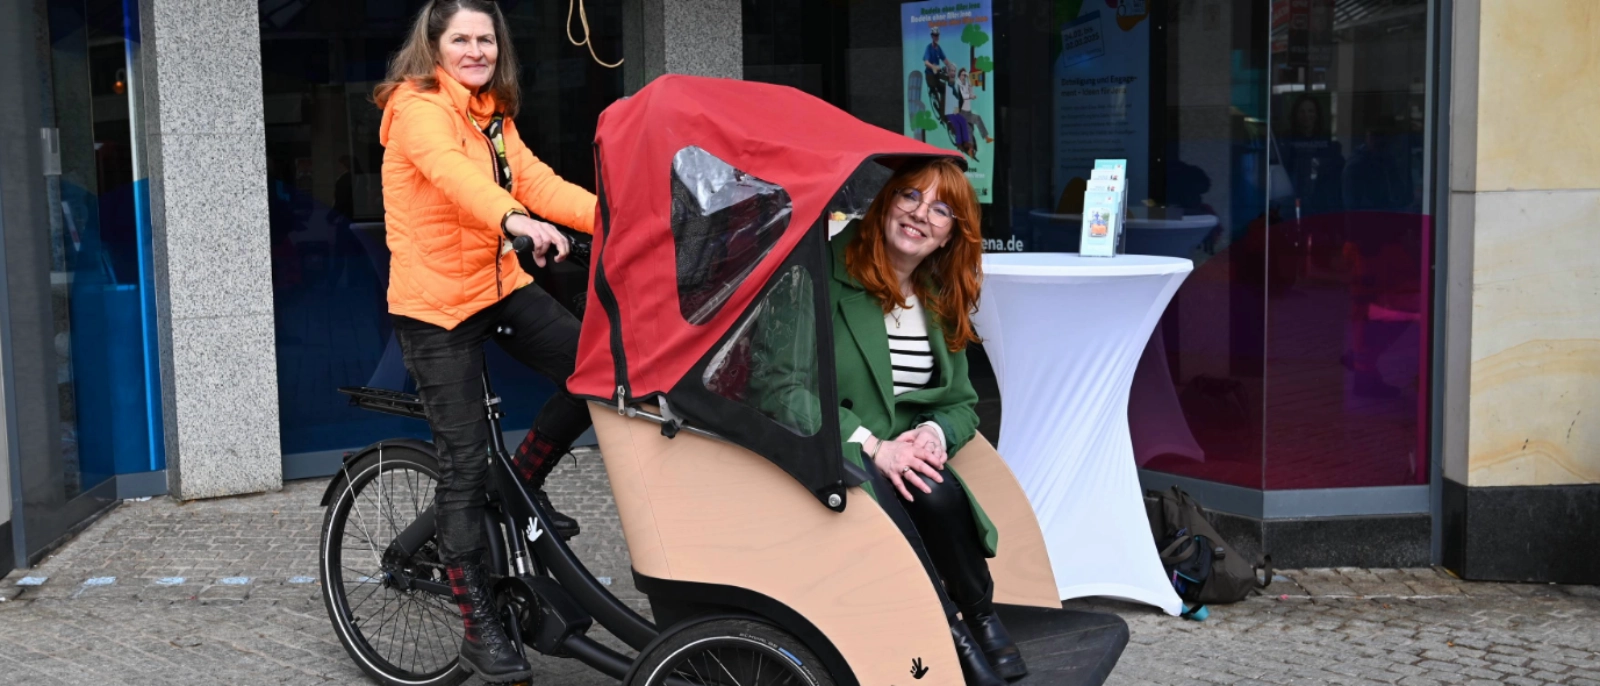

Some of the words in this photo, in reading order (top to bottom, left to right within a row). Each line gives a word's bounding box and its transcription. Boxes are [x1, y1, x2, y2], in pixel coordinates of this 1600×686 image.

[1060, 77, 1096, 87] Beteiligung
[1097, 75, 1109, 83] und
[1060, 89, 1077, 97] ment
[1082, 88, 1099, 96] Ideen
[981, 234, 1024, 252] ena.de
